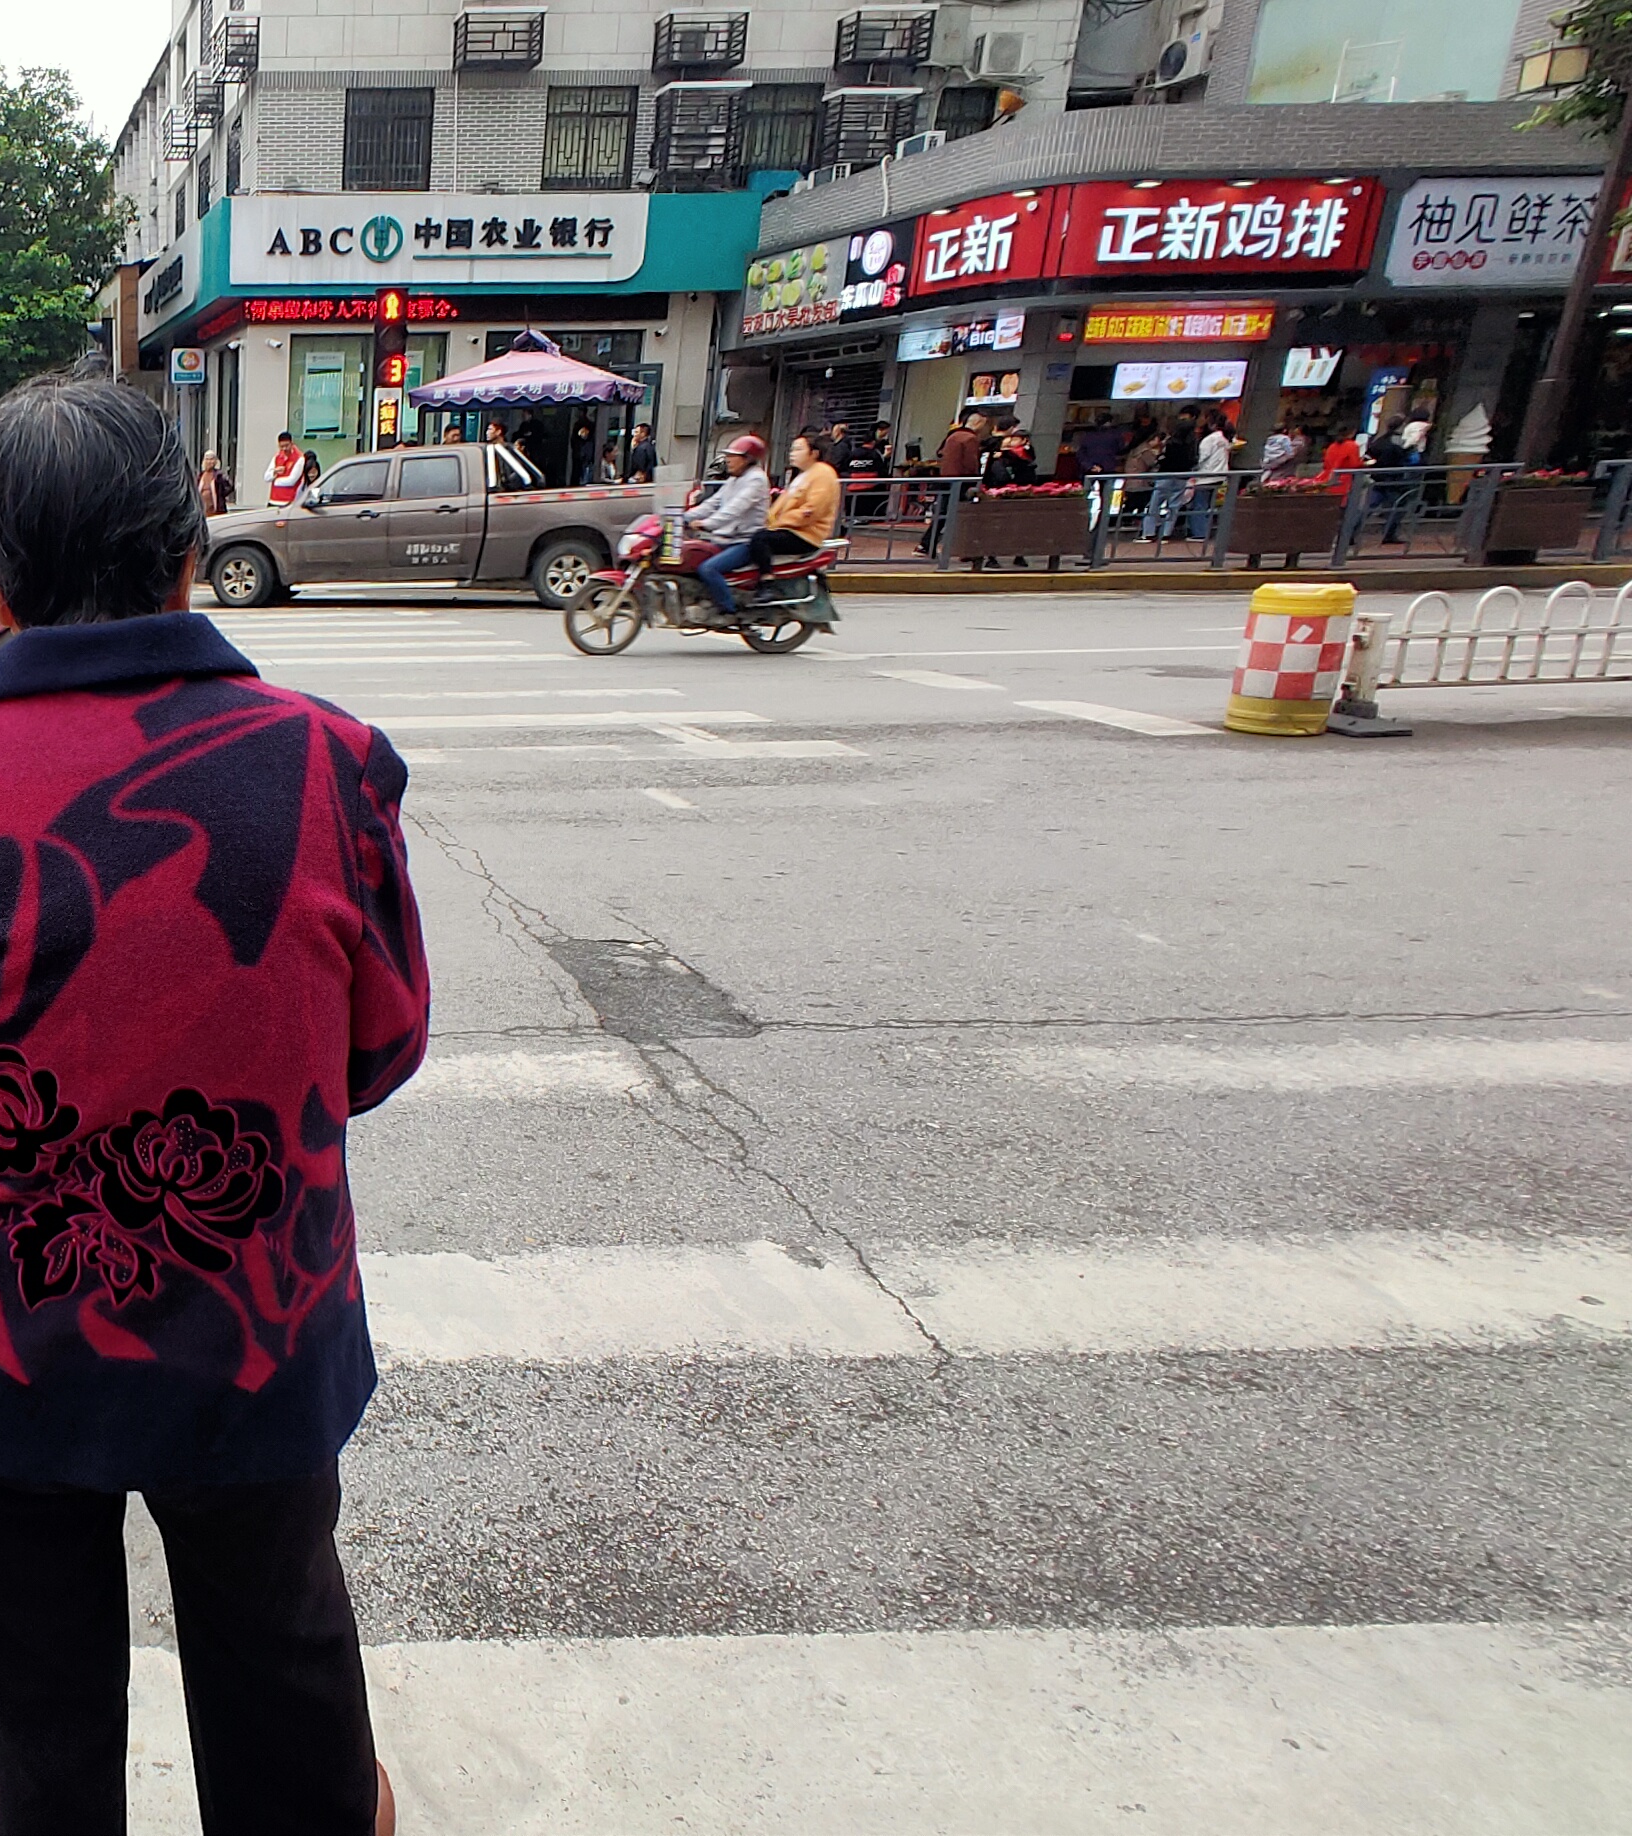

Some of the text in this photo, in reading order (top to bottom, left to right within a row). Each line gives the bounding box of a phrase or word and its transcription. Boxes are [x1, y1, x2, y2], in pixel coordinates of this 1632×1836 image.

[414, 217, 613, 249] 中国农业银行
[1097, 196, 1349, 263] 正新鸡排
[1408, 193, 1598, 246] 柚见鲜茶
[266, 227, 354, 255] ABC
[925, 213, 1018, 283] 正新
[970, 330, 995, 346] BIG
[390, 359, 403, 383] 3
